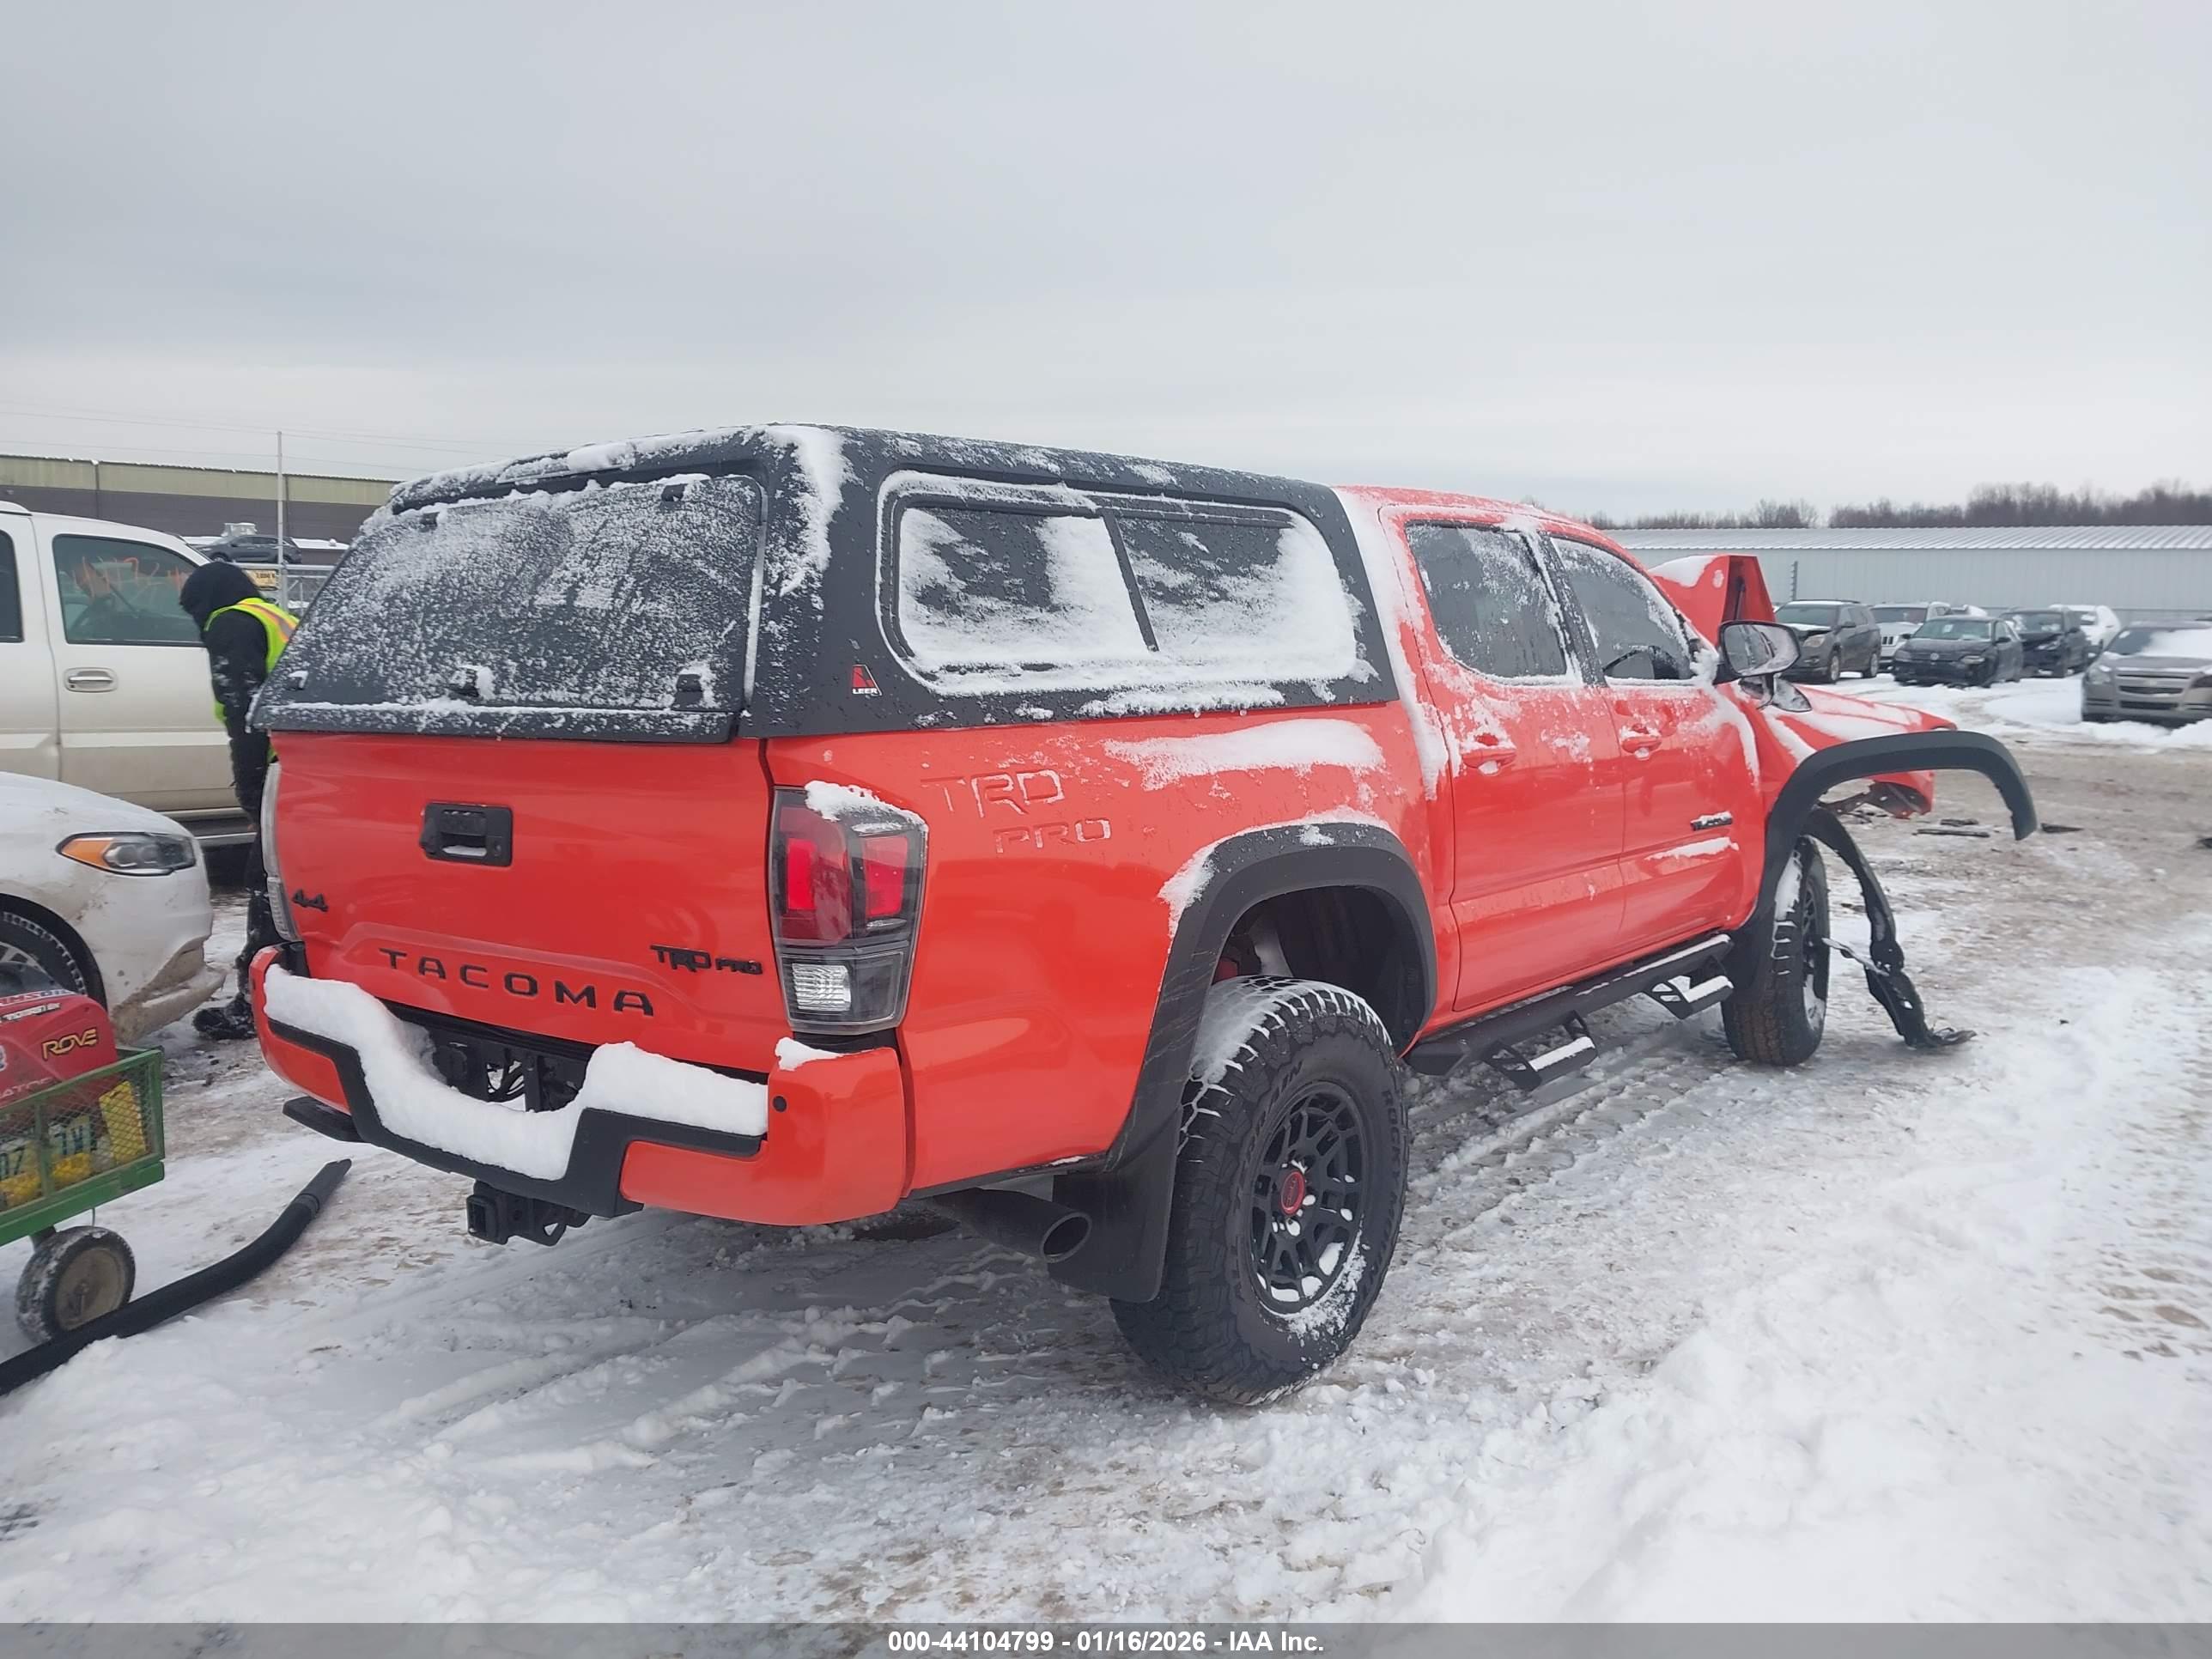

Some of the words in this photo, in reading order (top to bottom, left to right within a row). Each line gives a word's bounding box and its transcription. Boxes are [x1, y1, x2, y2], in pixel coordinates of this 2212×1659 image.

[920, 769, 1066, 818] TRD
[992, 817, 1112, 854] PRO
[650, 944, 712, 973] TRD
[714, 957, 763, 975] PRO
[380, 947, 654, 1017] TACOMA
[42, 1028, 97, 1060] ROVE
